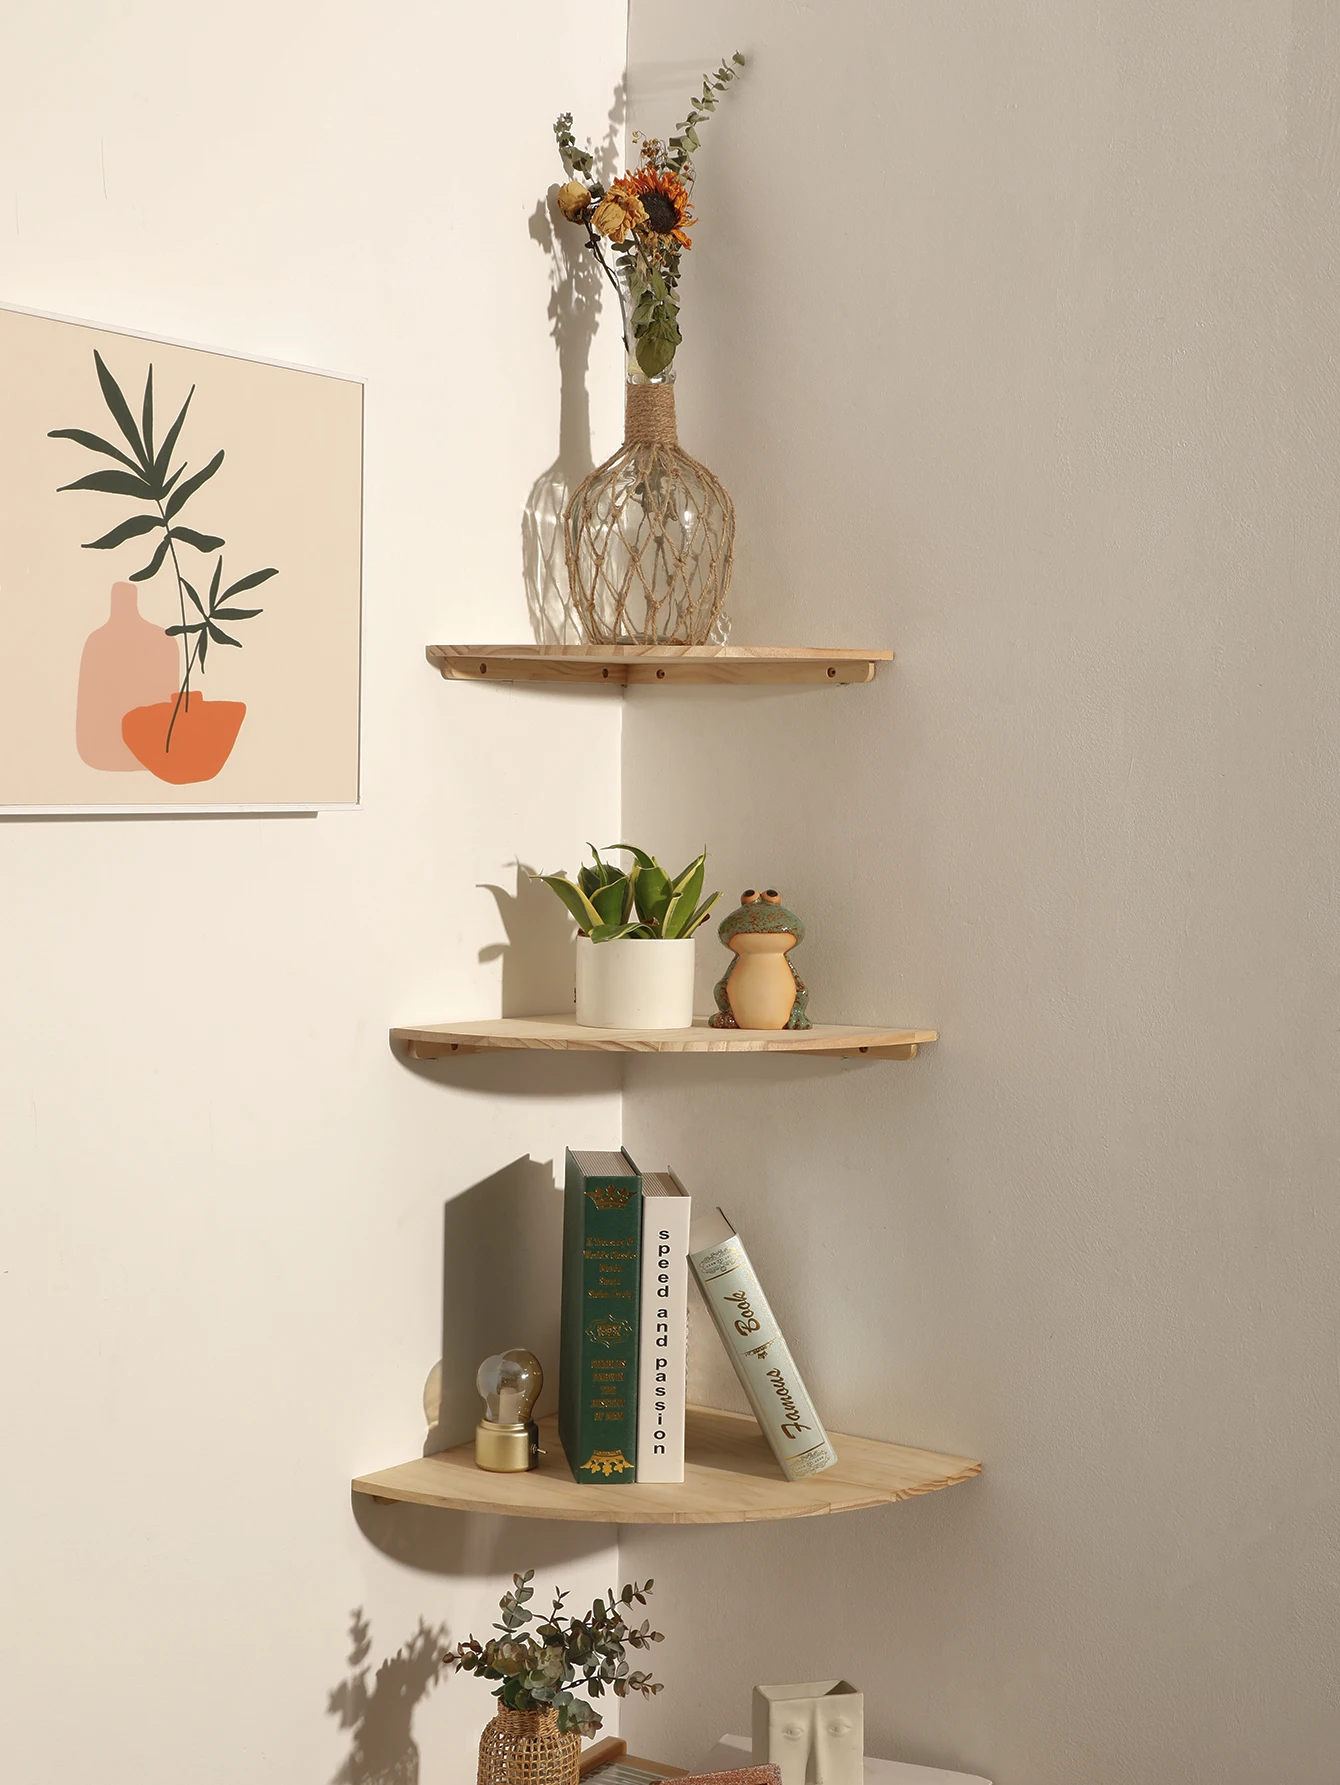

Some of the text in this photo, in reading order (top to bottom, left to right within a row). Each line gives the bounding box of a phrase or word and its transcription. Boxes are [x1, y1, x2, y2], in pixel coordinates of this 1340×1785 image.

[653, 1230, 671, 1454] speed and passion
[723, 1289, 761, 1337] Book
[766, 1367, 812, 1440] Famous
